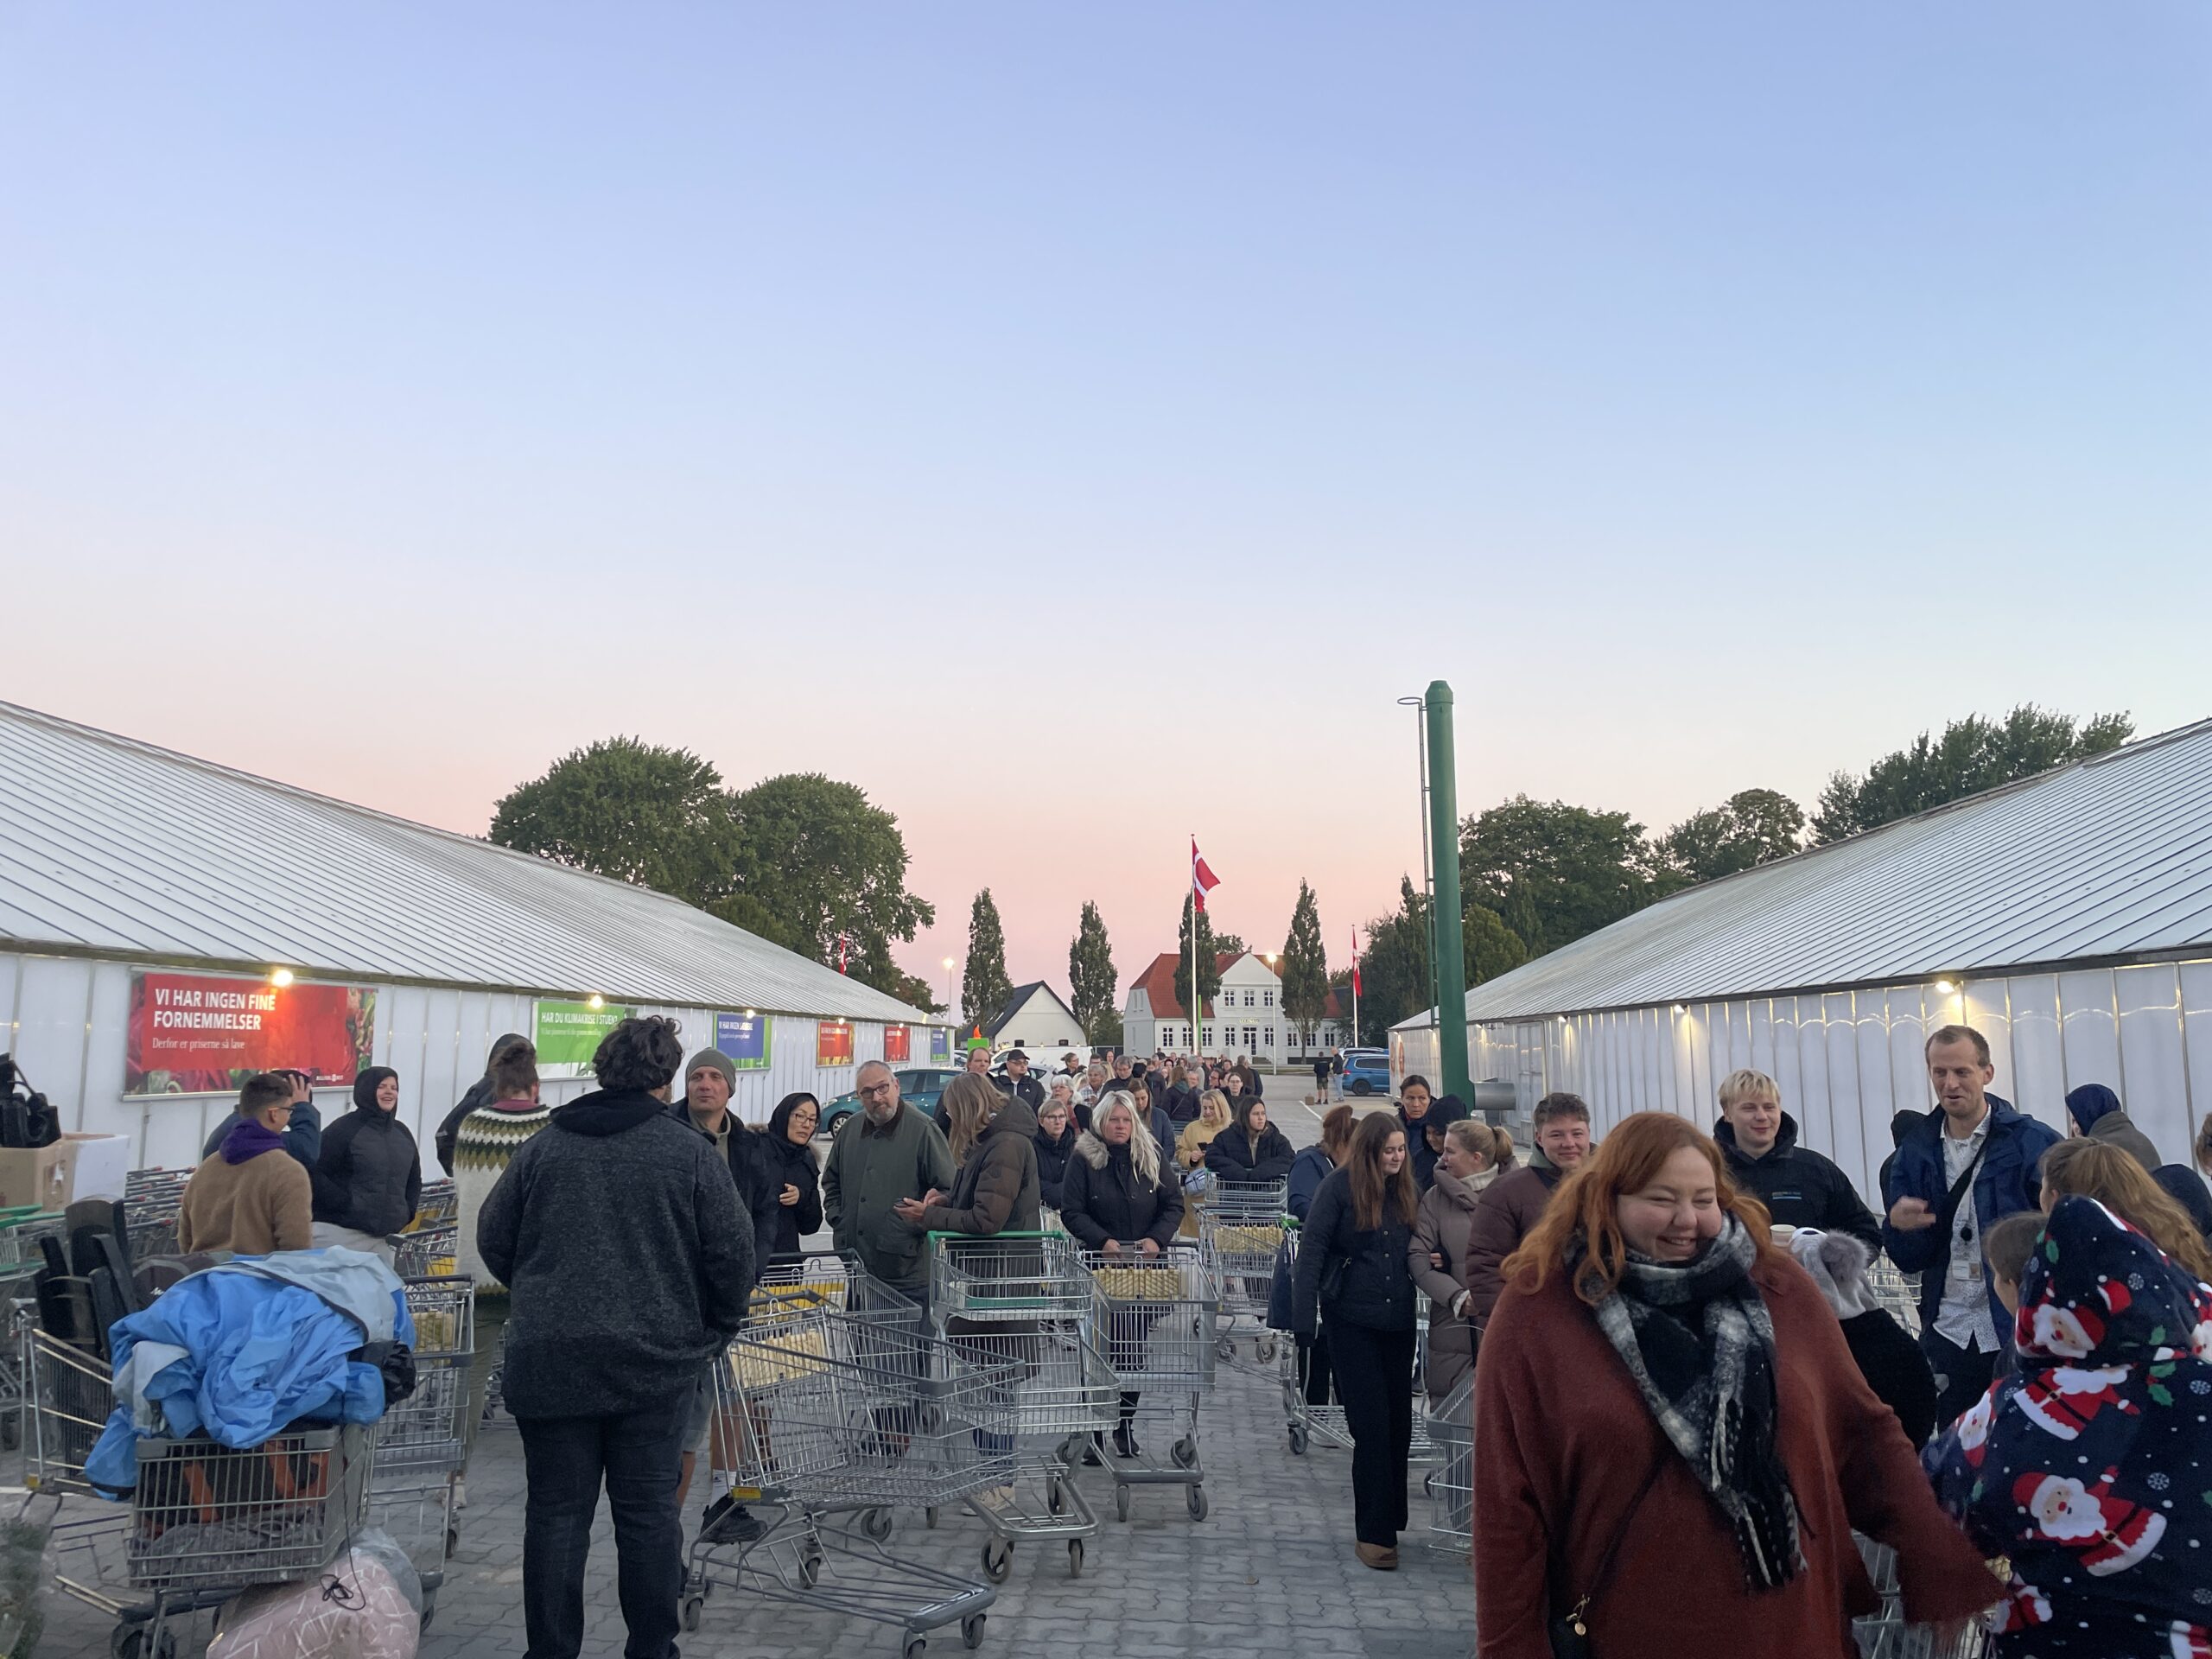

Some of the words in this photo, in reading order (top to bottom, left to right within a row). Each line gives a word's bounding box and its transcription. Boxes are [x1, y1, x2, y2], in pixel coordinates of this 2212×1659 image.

[156, 988, 169, 1006] VI
[173, 989, 202, 1007] HAR
[205, 991, 245, 1009] INGEN
[248, 994, 276, 1011] FINE
[154, 1010, 262, 1030] FORNEMMELSER
[541, 1012, 554, 1023] HAR
[555, 1013, 563, 1023] DU
[564, 1013, 596, 1025] KLIMAKRISE
[152, 1037, 178, 1049] Derfor
[180, 1040, 188, 1049] er
[189, 1038, 220, 1052] priserne
[220, 1039, 230, 1049] så
[231, 1038, 245, 1049] lave
